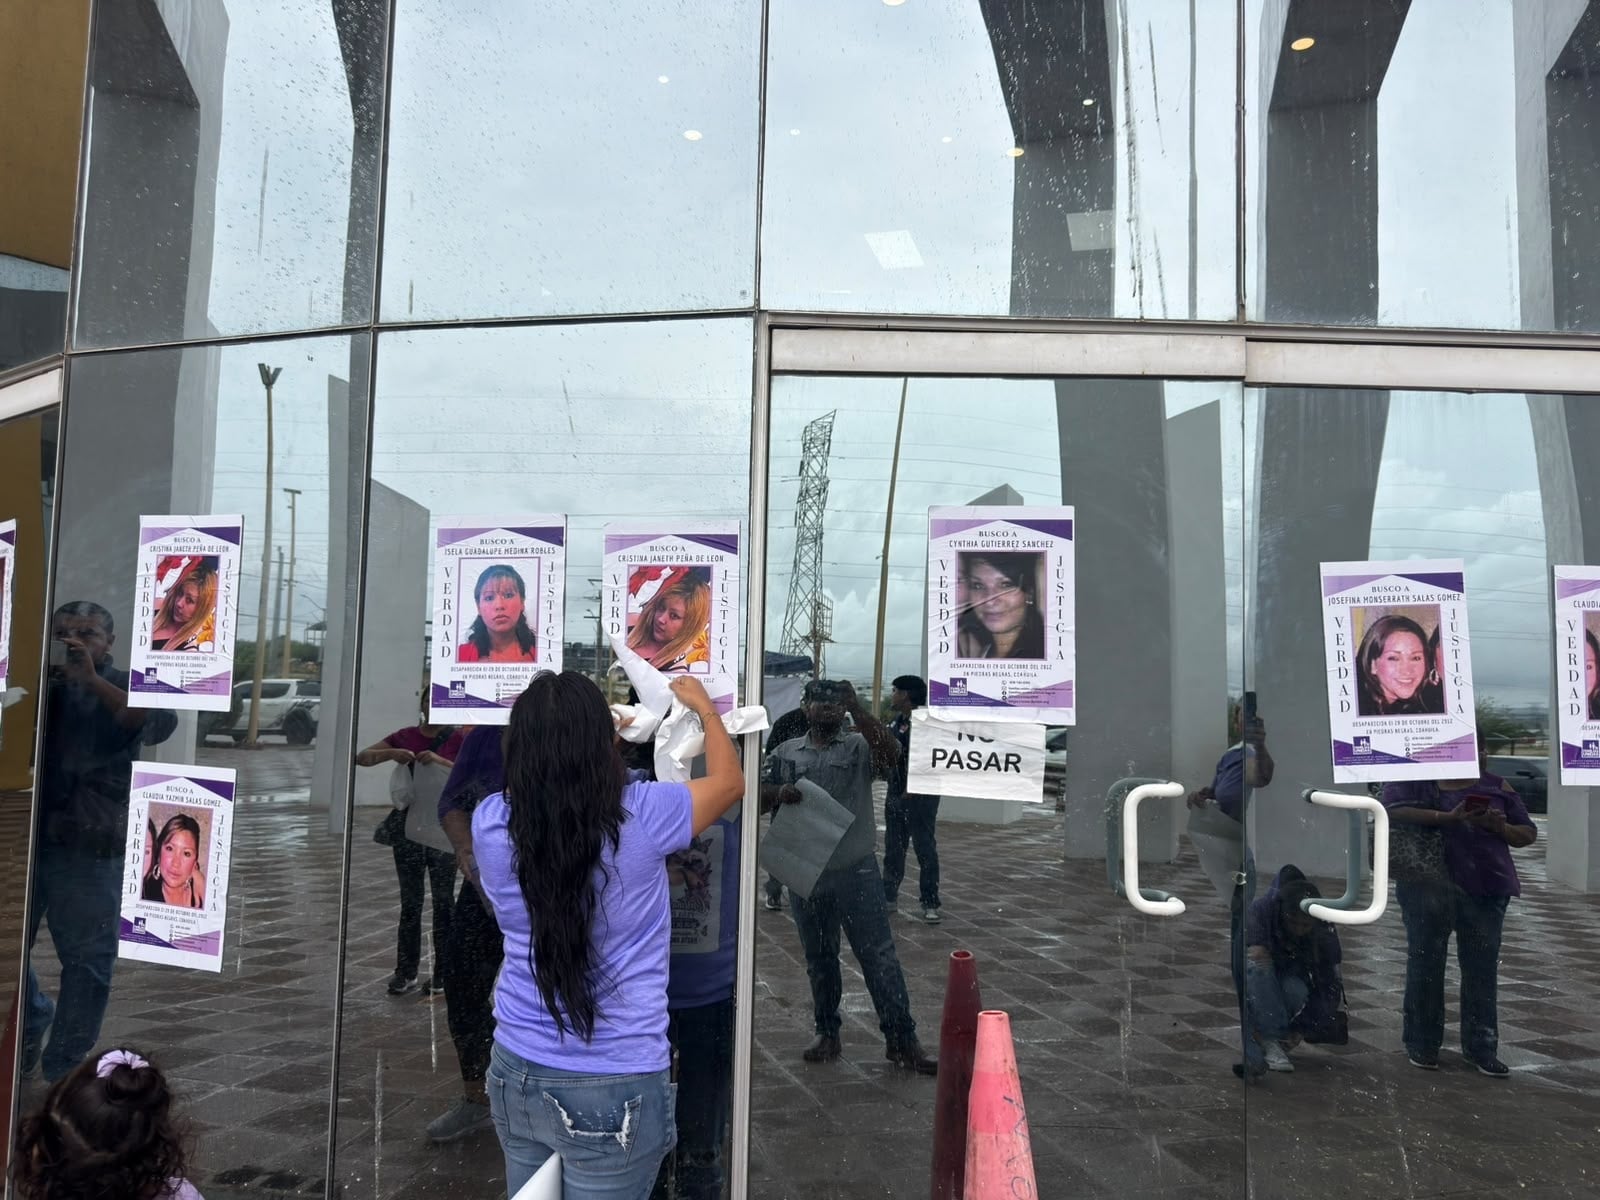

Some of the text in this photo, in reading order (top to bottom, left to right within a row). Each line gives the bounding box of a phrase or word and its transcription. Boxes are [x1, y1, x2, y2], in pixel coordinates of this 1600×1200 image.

[618, 553, 724, 563] CRISTINA JANETH PEÑA DE LEON
[949, 540, 1053, 548] CYNTHIA GUTIERREZ SANCHEZ
[140, 562, 152, 646] VERDAD
[222, 558, 232, 653] JUSTICIA
[441, 566, 453, 658] VERDAD
[546, 561, 554, 663] JUSTICIA
[718, 569, 730, 674] JUSTICIA
[939, 559, 950, 654] VERDAD
[1055, 555, 1064, 661] JUSTICIA
[1328, 596, 1360, 606] JOSEFINA
[1363, 595, 1410, 603] MONSERRATH
[1412, 594, 1435, 602] SALAS
[1334, 616, 1350, 713] VERDAD
[1450, 608, 1464, 714] JUSTICIA
[1567, 620, 1581, 716] VERDAD
[142, 792, 164, 800] CLAUDIA
[186, 796, 202, 804] SALAS
[204, 799, 221, 807] GOMEZ
[931, 748, 1022, 773] PASAR
[129, 808, 144, 895] VERDAD
[210, 814, 224, 912] JUSTICIA
